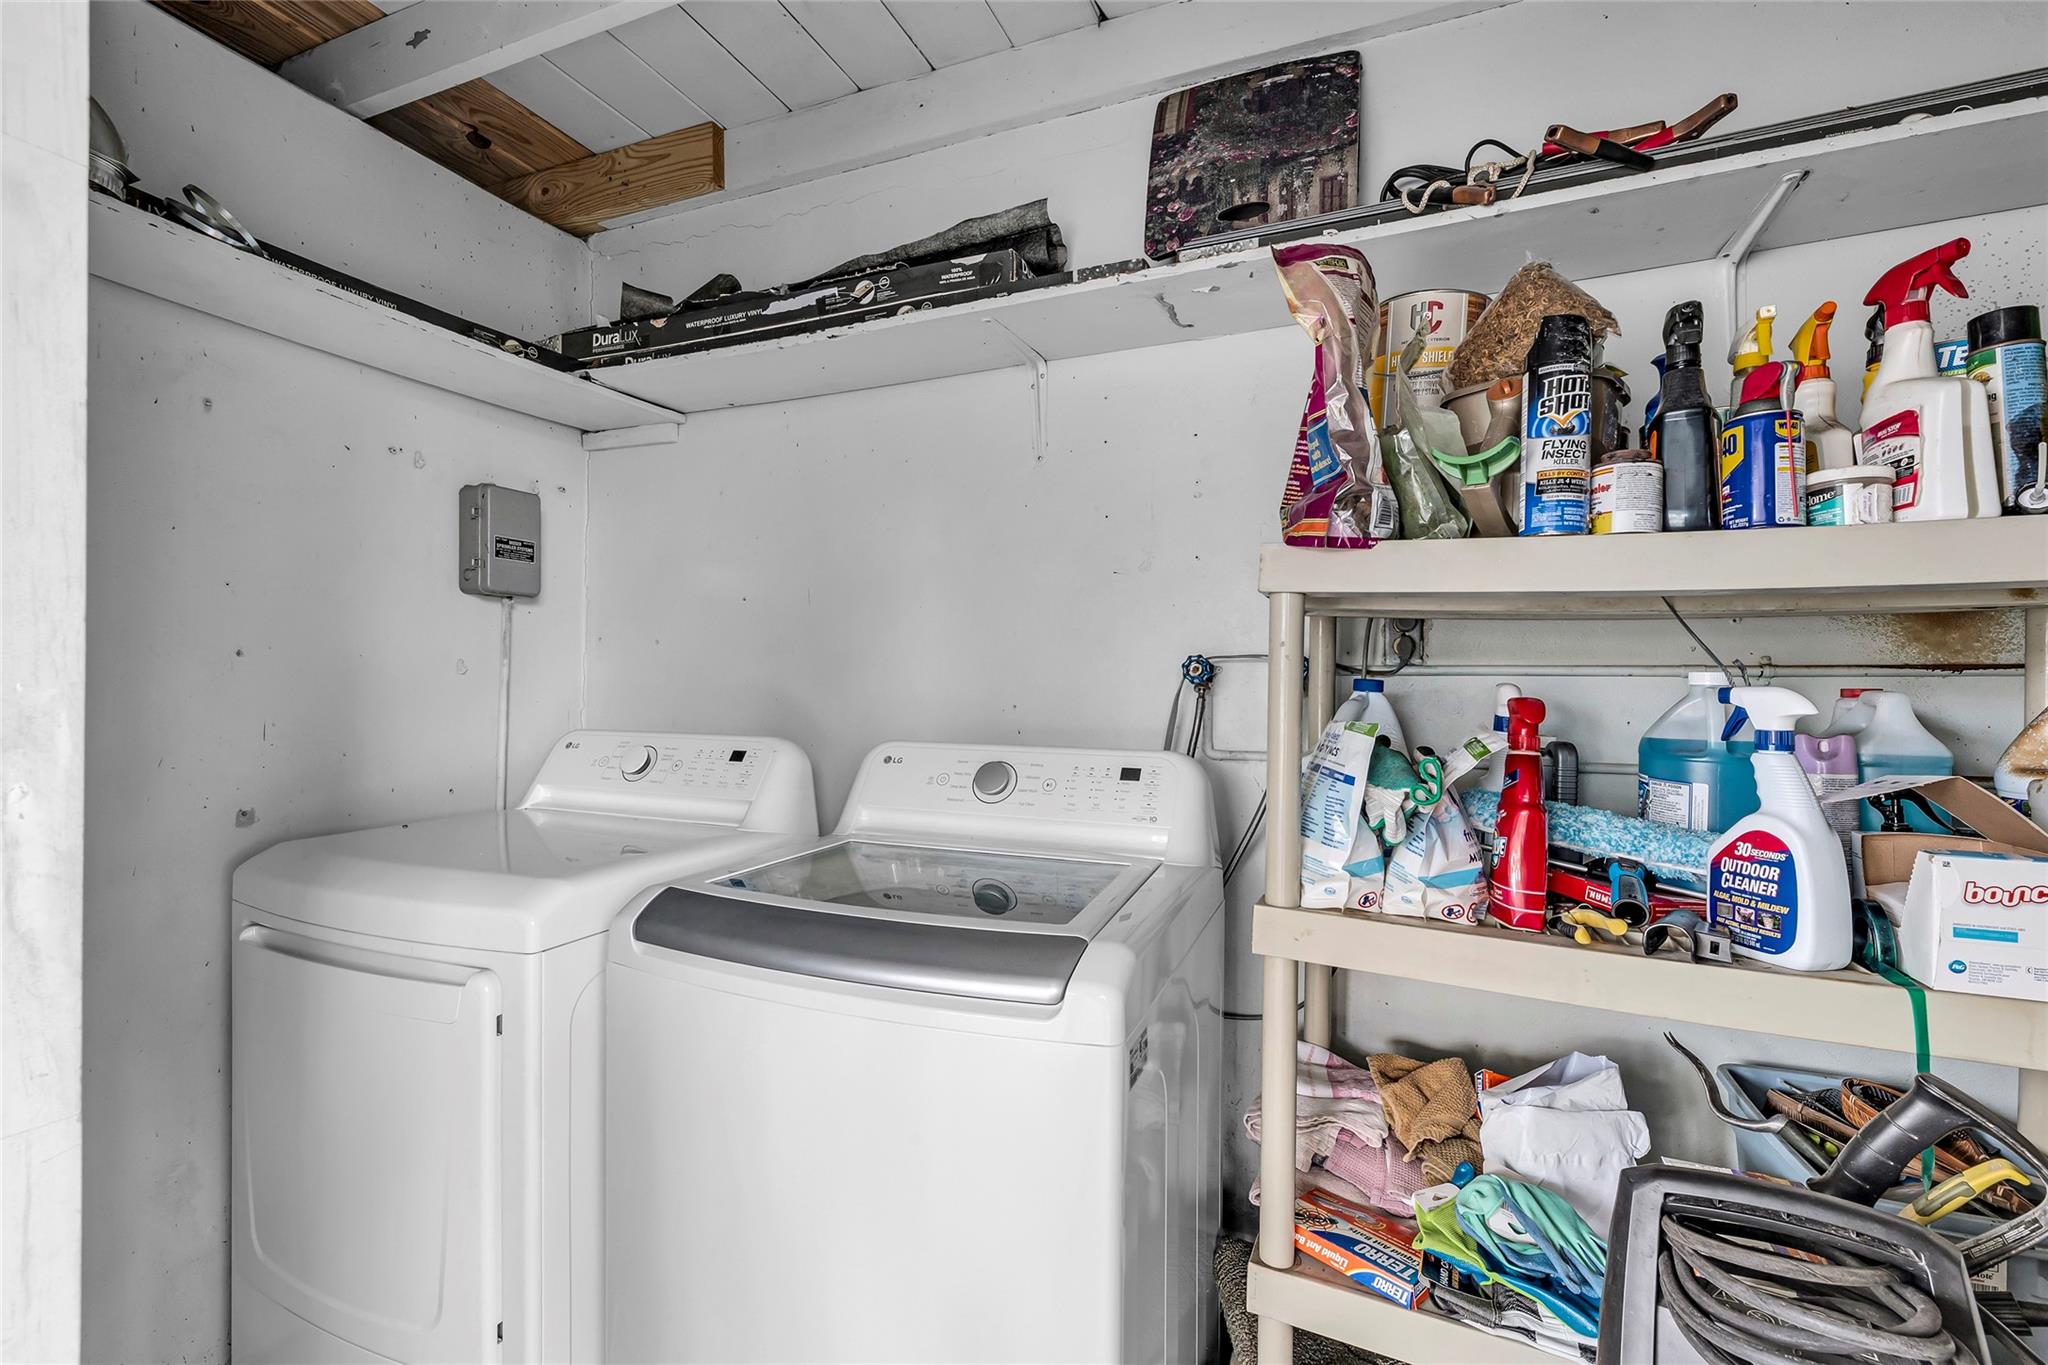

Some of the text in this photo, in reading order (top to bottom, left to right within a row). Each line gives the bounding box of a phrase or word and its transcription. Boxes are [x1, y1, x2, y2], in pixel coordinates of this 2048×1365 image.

[941, 270, 973, 280] WATERPROOF
[685, 316, 723, 330] WATERPROOF
[723, 311, 747, 323] LUXURY
[747, 308, 763, 317] VINYL
[592, 328, 642, 347] DuraLux
[1543, 374, 1589, 400] HOT
[1537, 392, 1591, 418] SHOT
[1886, 421, 1902, 433] STOP
[1541, 439, 1587, 451] FLYING
[1541, 449, 1587, 460] INSECT
[1734, 841, 1787, 861] 30 SECONDS
[1720, 857, 1780, 881] OUTDOOR
[1720, 872, 1778, 898] CLEANER
[1731, 895, 1750, 906] MOLD
[1750, 900, 1757, 908] &
[1756, 901, 1790, 915] MILDEW
[1349, 1226, 1373, 1242] Baits
[1305, 1239, 1322, 1254] Ant
[1372, 1237, 1392, 1252] Ant
[1321, 1248, 1349, 1268] Liquid
[1353, 1243, 1416, 1281] TERRO
[1373, 1276, 1410, 1305] TERRO
